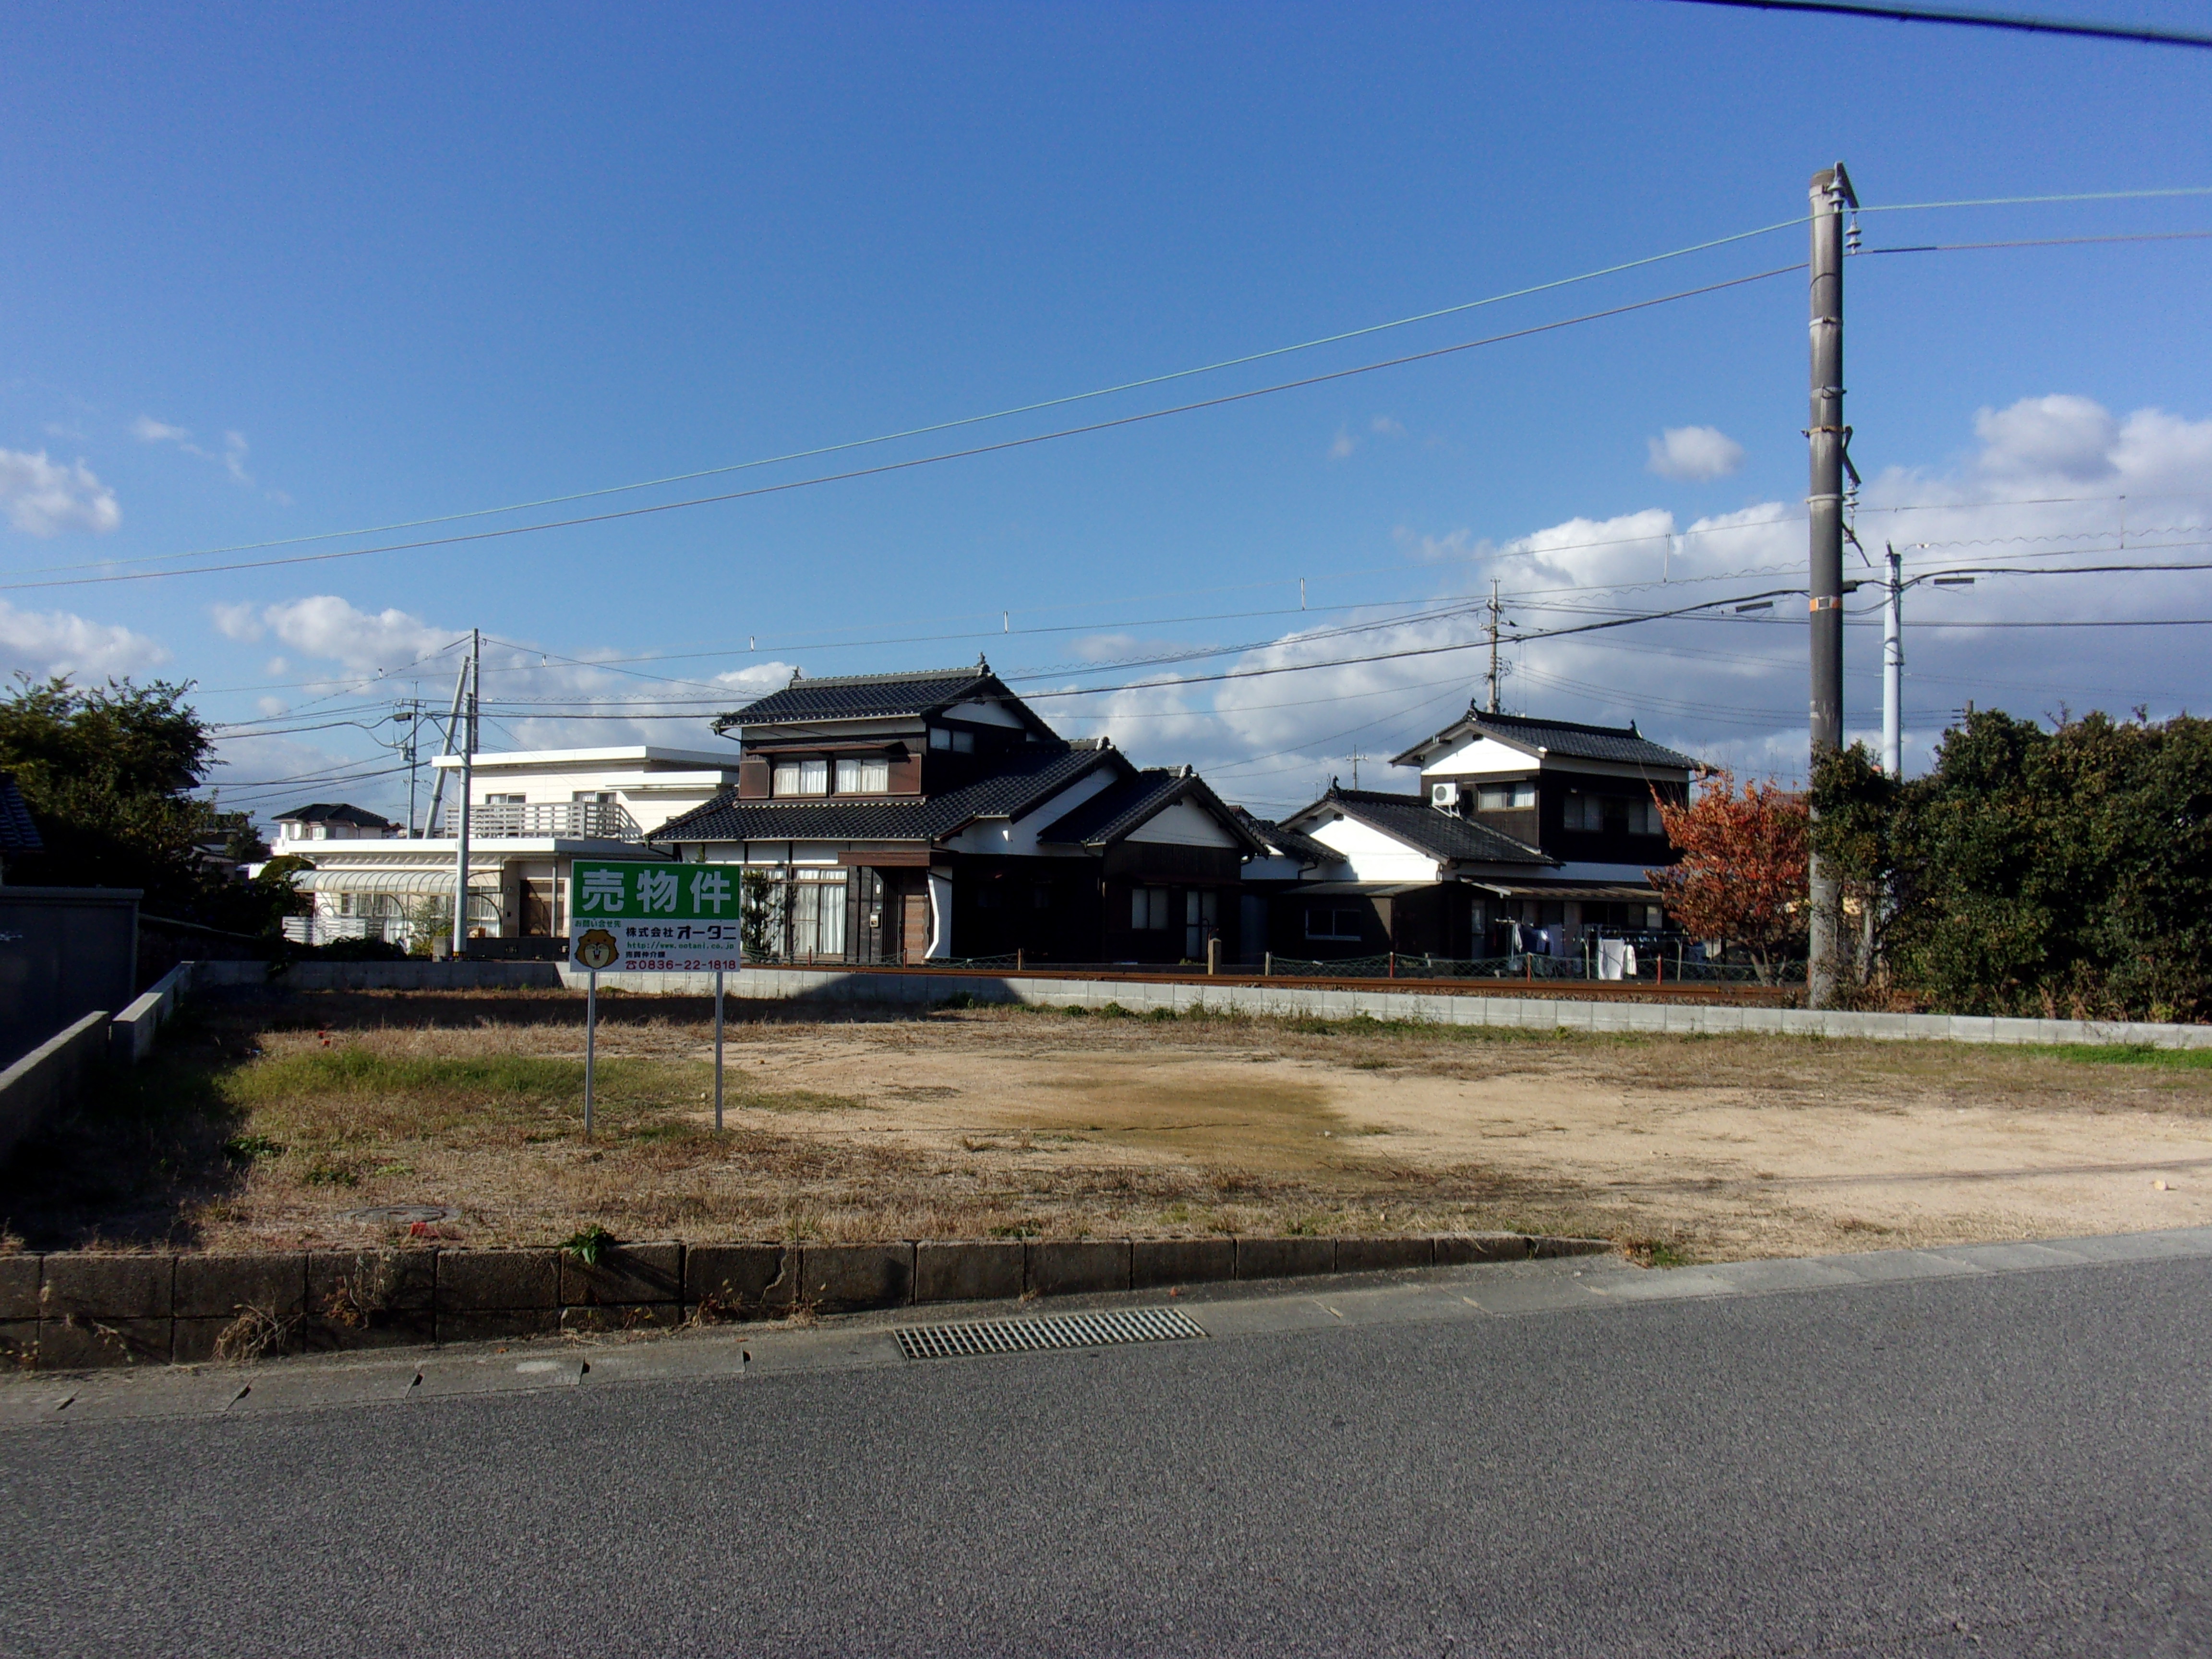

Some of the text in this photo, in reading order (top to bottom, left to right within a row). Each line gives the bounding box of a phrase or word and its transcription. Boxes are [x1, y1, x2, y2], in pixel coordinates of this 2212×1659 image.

[582, 868, 732, 914] 売物件
[627, 941, 734, 950] http://www.ootani.co.jp
[638, 960, 736, 970] 0836-22-1818
